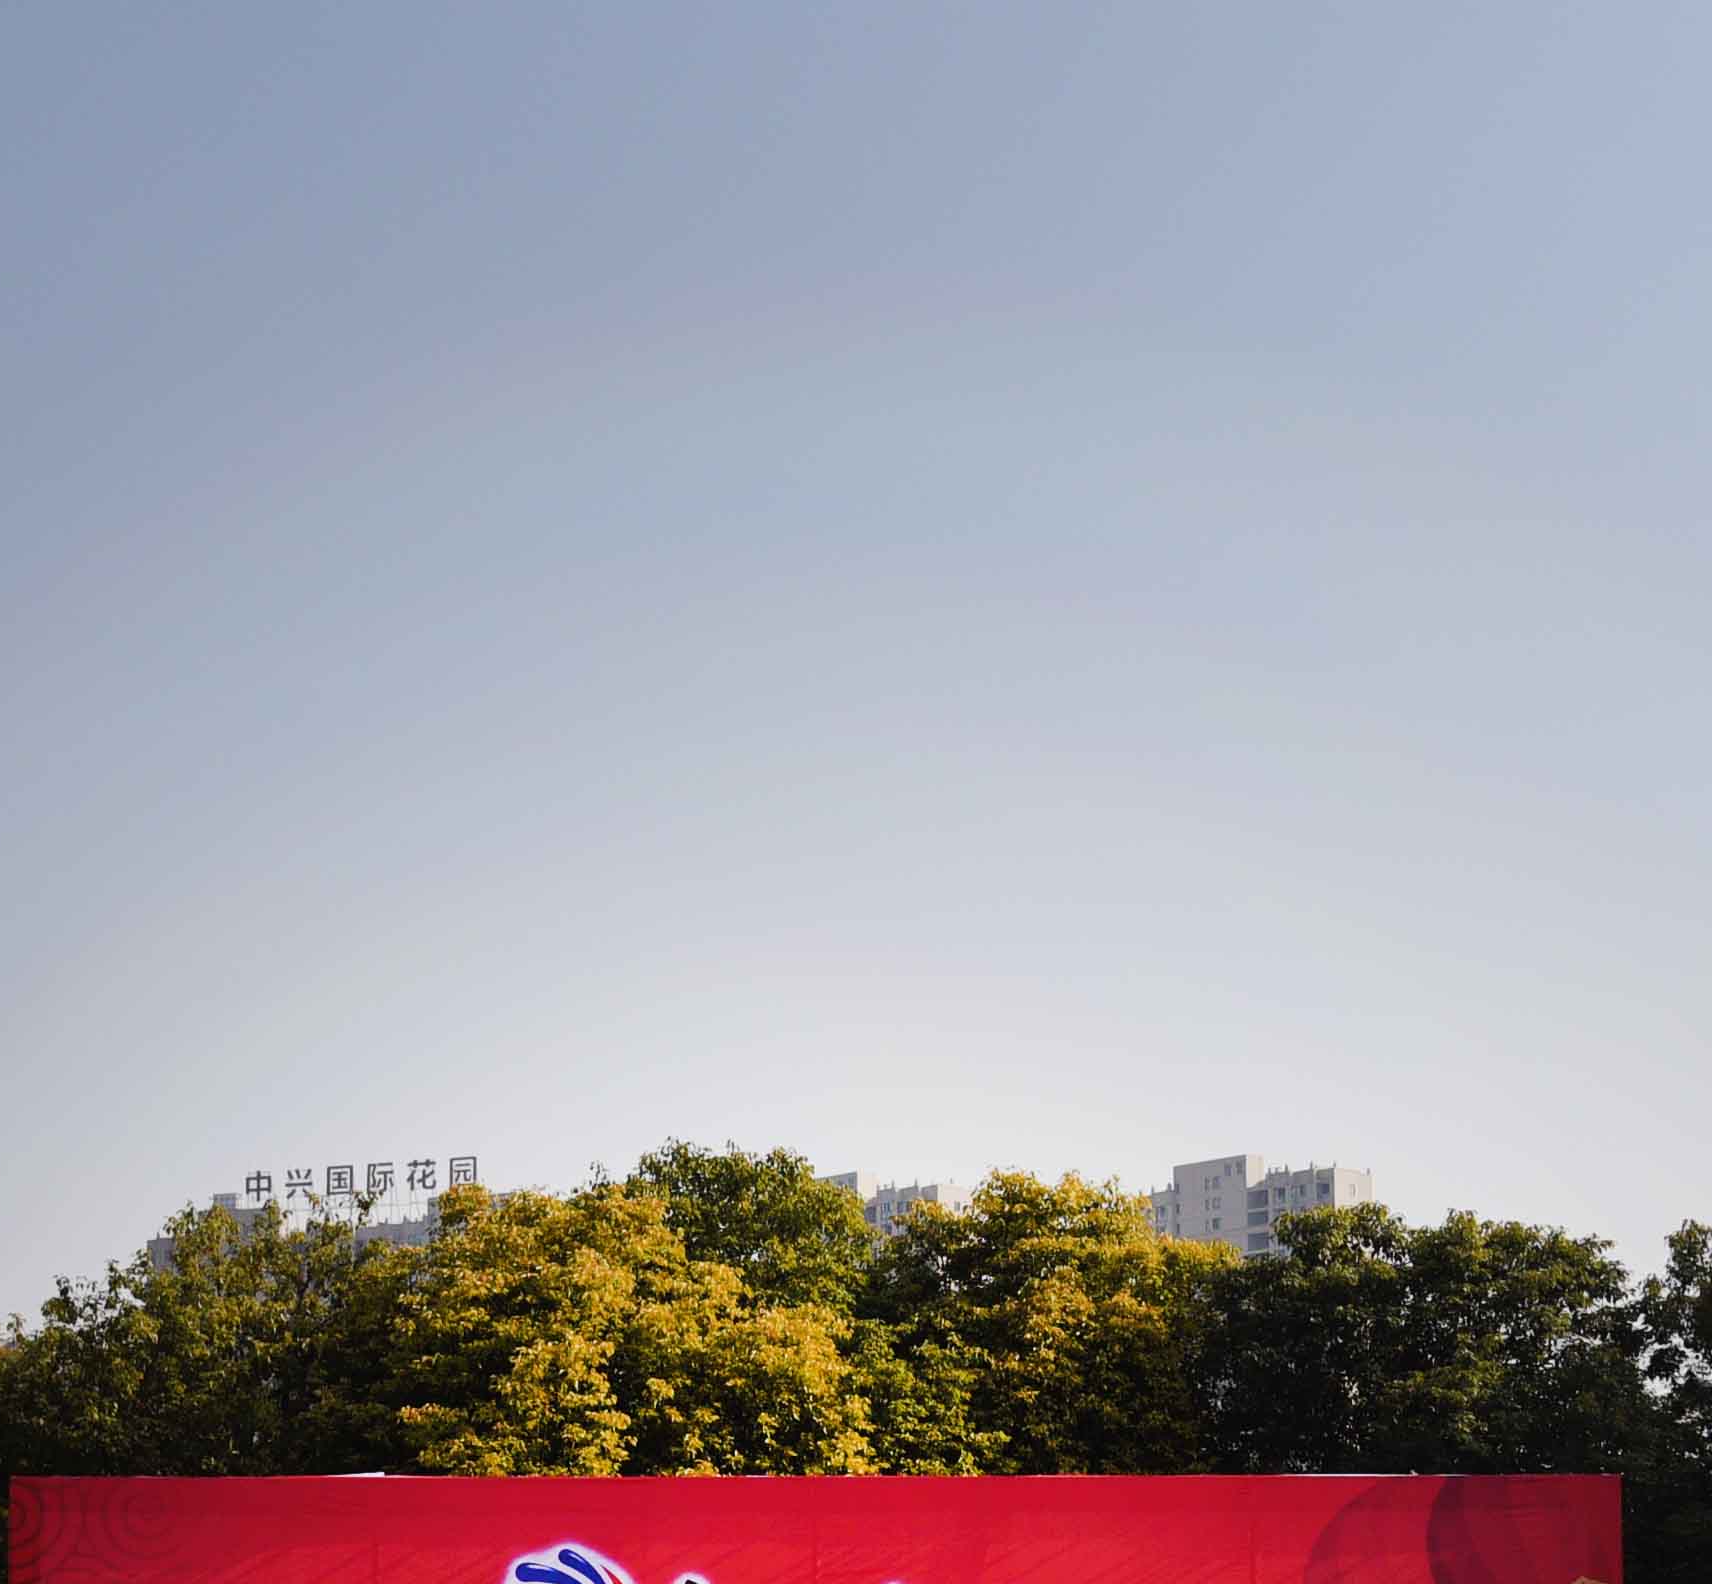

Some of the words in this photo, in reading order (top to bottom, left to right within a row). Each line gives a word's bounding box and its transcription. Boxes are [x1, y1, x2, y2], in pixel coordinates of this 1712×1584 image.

[245, 1155, 478, 1203] 中兴国际花园
